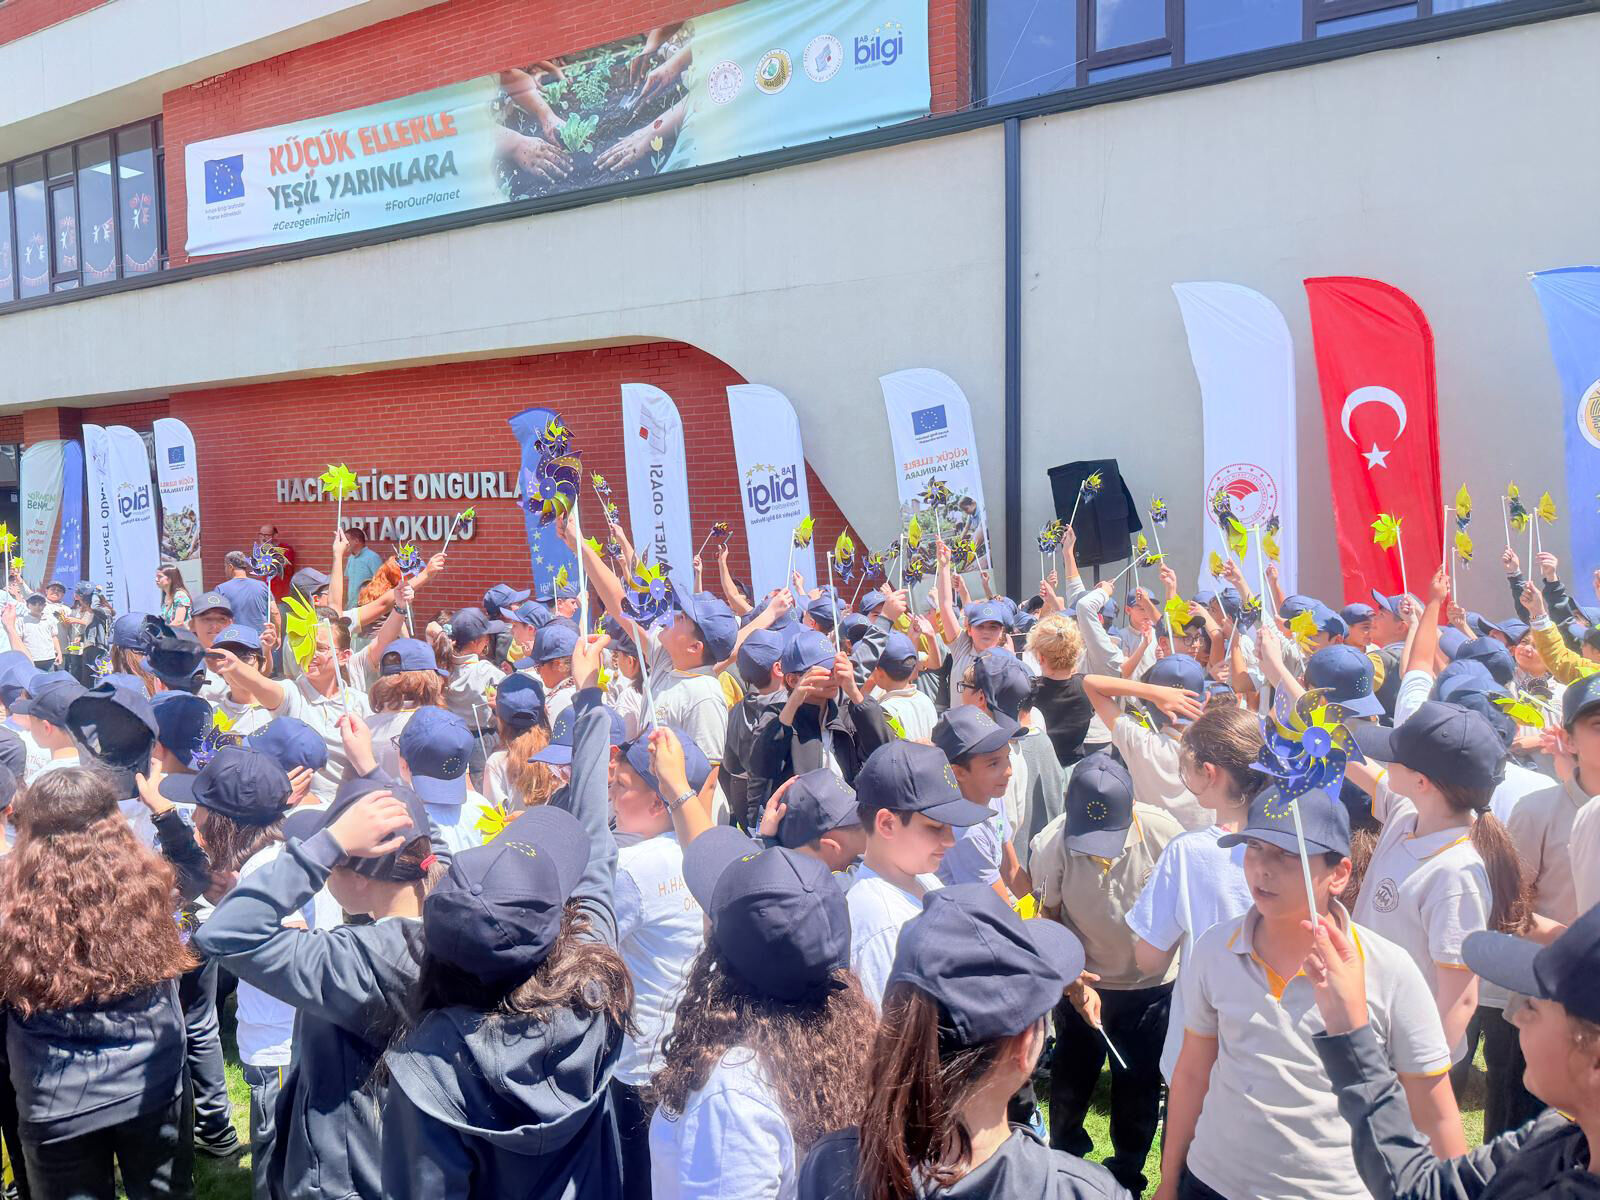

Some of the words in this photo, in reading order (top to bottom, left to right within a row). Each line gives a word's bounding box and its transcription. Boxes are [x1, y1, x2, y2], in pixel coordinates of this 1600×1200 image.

[854, 31, 903, 66] bilgi
[859, 34, 869, 43] AB
[269, 128, 355, 177] KÜÇÜK
[358, 111, 458, 157] ELLERLE
[267, 172, 320, 214] YEŞİL
[326, 150, 459, 200] YARINLARA
[273, 208, 351, 231] #Gezegenimizİçin
[385, 188, 461, 212] #ForOurPlanet
[276, 477, 323, 503] HACI
[330, 468, 408, 502] TİCE
